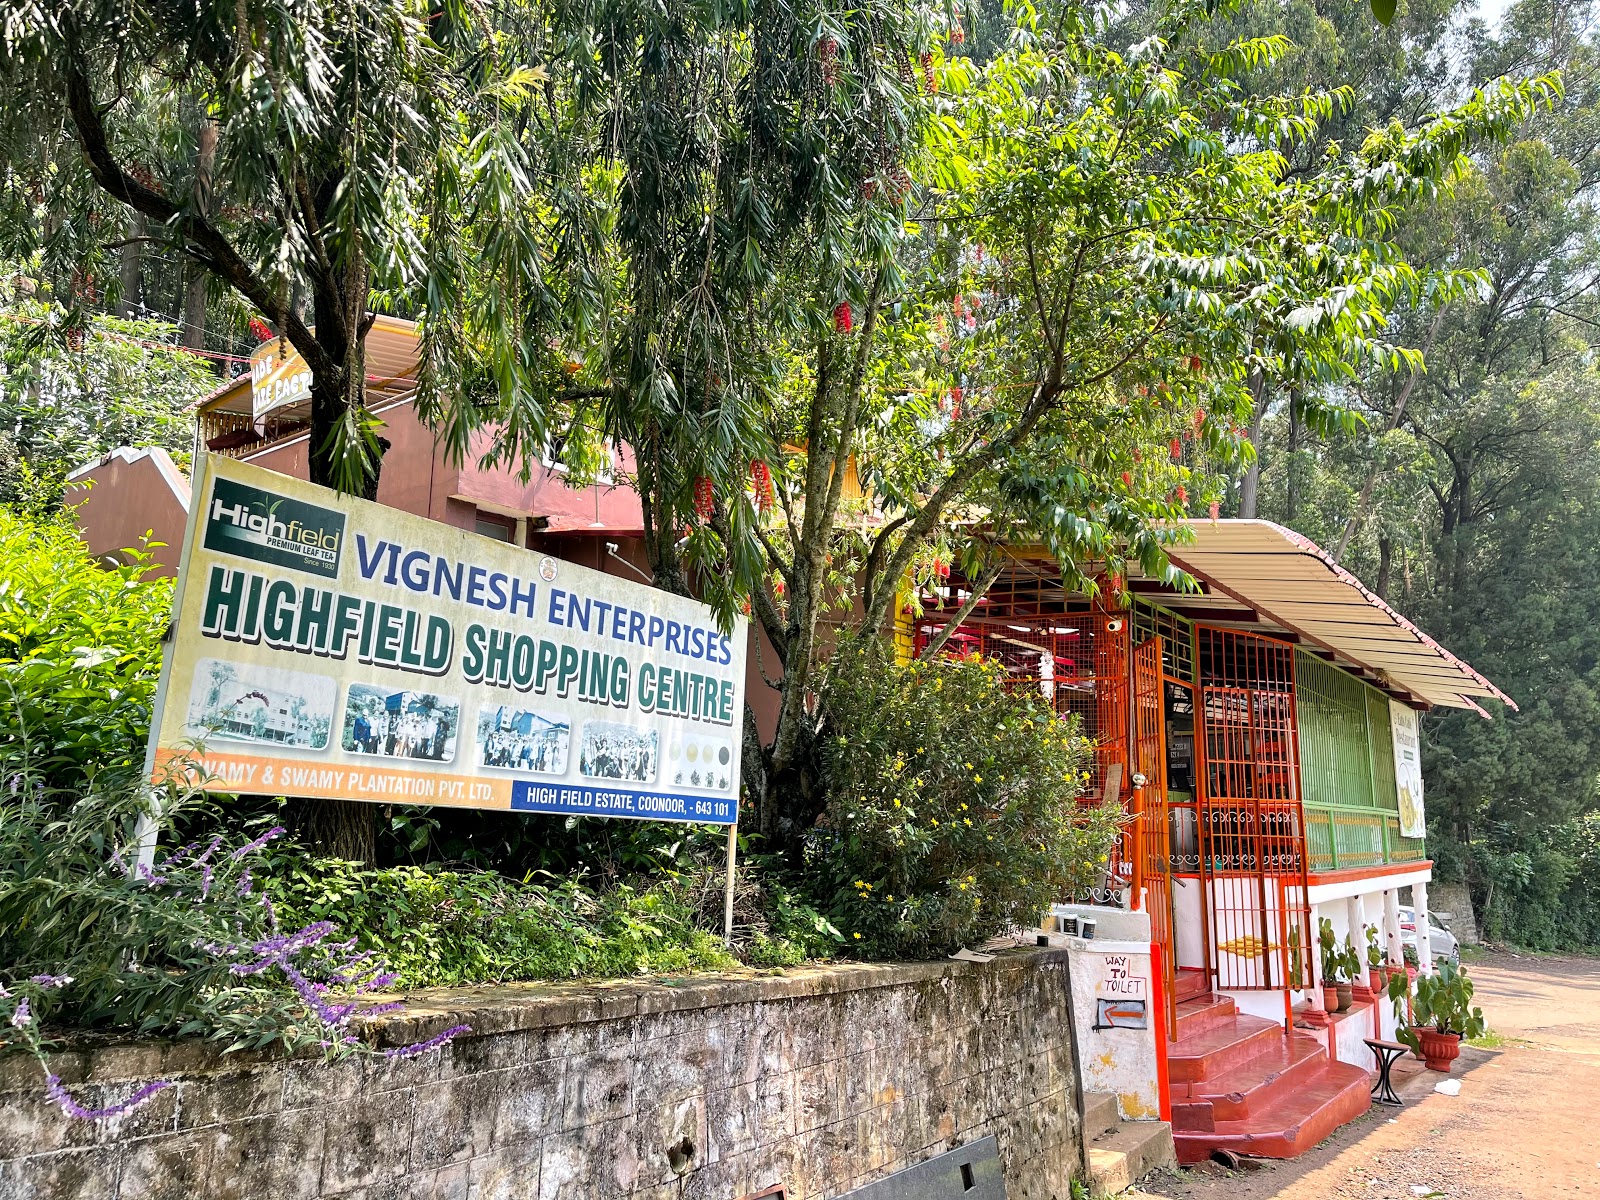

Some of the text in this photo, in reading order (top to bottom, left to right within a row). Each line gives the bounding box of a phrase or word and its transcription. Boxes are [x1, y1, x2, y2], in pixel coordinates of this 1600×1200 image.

[276, 371, 313, 400] FACT
[212, 499, 340, 551] Highfield
[267, 537, 334, 560] PREMIUM LEAF TEA
[304, 557, 335, 571] Since 1930
[356, 534, 732, 665] VIGNESH ENTERPRISES
[202, 566, 733, 724] HIGHFIELD SHOPPING CENTRE
[262, 766, 274, 784] &
[280, 767, 347, 790] SWAMY
[349, 774, 434, 798] PLANTATION
[439, 782, 465, 799] PVT.
[470, 783, 494, 801] LTD.
[527, 787, 557, 805] HIGH
[560, 789, 592, 807] FIELD
[595, 793, 635, 812] ESTATE,
[638, 796, 687, 815] COONOOR,
[695, 800, 712, 815] 643
[714, 802, 729, 817] 101
[1105, 957, 1126, 966] WAY
[1110, 969, 1126, 978] TO
[1105, 980, 1141, 993] TOILET
